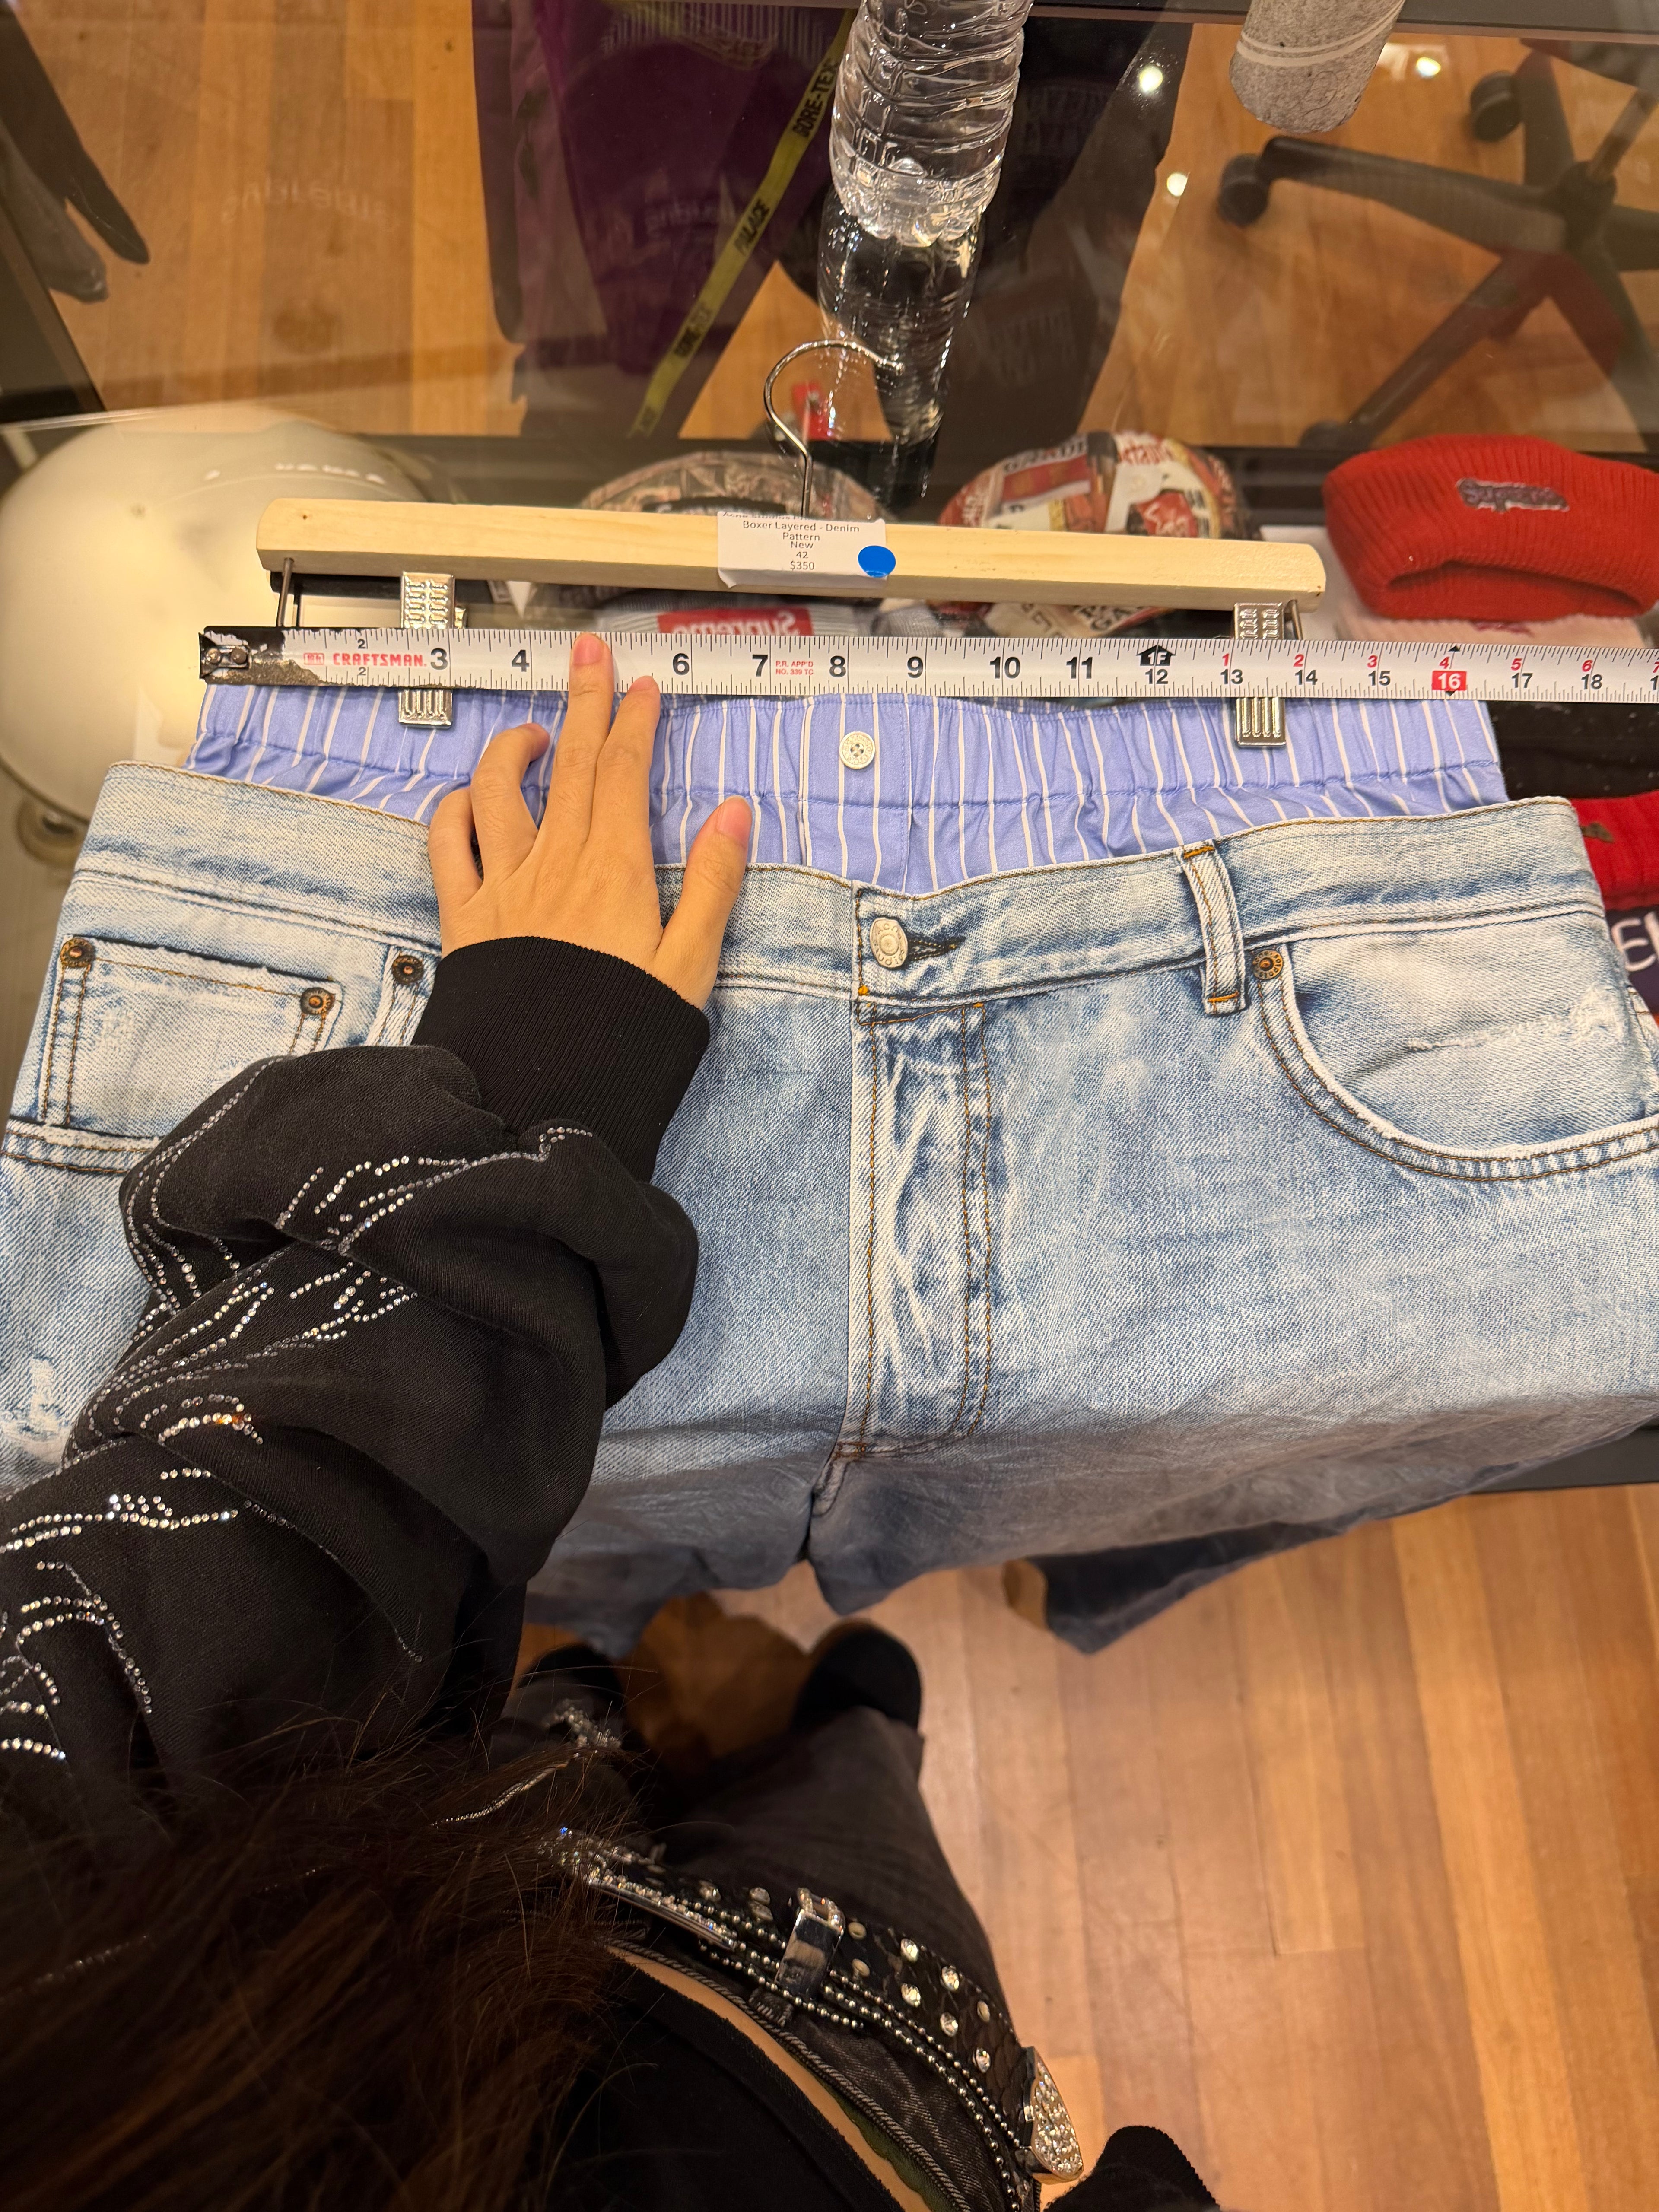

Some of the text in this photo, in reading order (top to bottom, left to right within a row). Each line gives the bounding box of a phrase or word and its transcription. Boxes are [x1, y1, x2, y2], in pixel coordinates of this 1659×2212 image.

[743, 520, 772, 529] Boxer
[775, 521, 816, 531] Layered
[826, 524, 860, 533] Denim
[782, 532, 820, 541] Pattern
[790, 560, 815, 571] $350
[357, 639, 366, 649] 2
[430, 648, 448, 671] 3
[511, 649, 530, 672] 4
[672, 653, 690, 676] 6
[752, 654, 769, 677] 7
[829, 655, 846, 678] 8
[1222, 654, 1230, 667] 1
[1293, 654, 1305, 667] 2
[1367, 655, 1378, 668] 3
[1439, 657, 1450, 669] 4
[1510, 658, 1522, 671] 5
[1582, 659, 1593, 672] 6
[358, 667, 366, 676] 2
[906, 656, 924, 679] 9
[989, 656, 1021, 680] 10
[1066, 656, 1094, 680] 11
[1144, 669, 1169, 685] 12
[1220, 670, 1244, 685] 13
[1295, 671, 1318, 686] 14
[1368, 671, 1391, 686] 15
[1437, 673, 1461, 689] 16
[1512, 672, 1533, 689] 17
[1581, 674, 1602, 690] 18
[1650, 676, 1659, 691] 1
